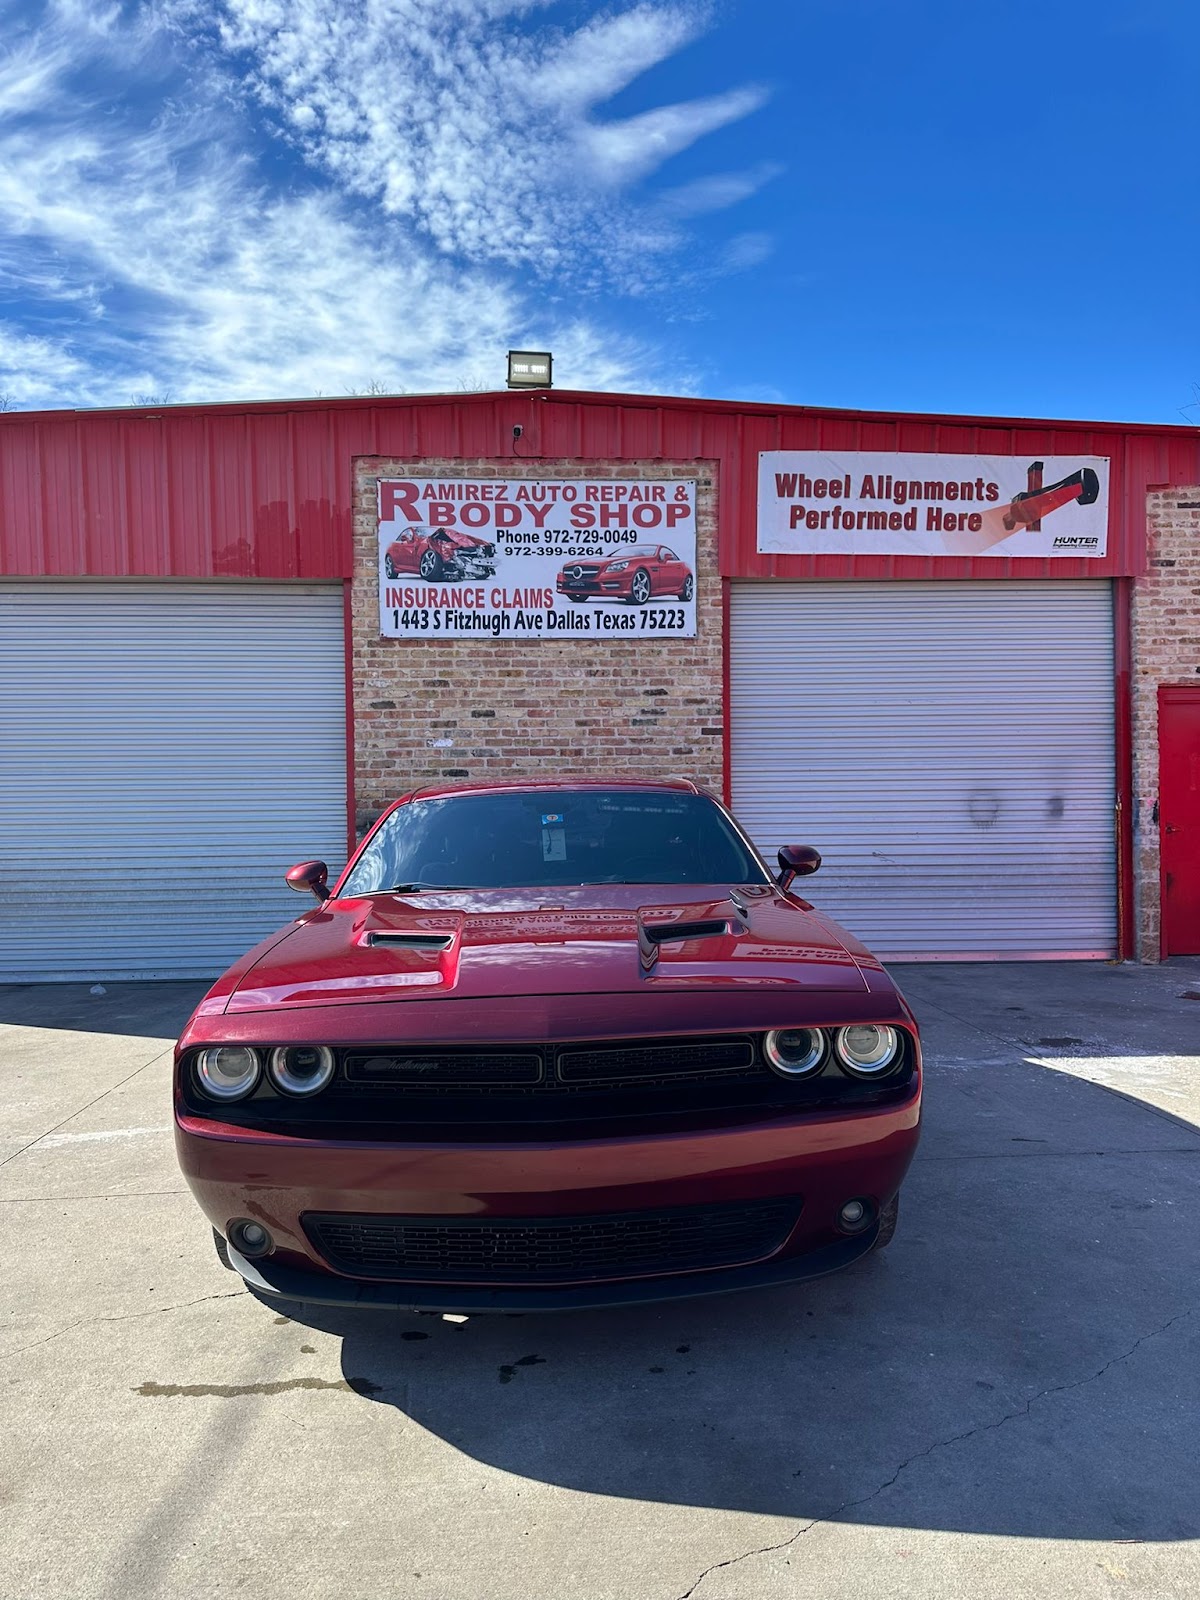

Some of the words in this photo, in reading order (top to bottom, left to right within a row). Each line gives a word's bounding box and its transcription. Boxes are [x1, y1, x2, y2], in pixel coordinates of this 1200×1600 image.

[379, 481, 508, 522] RAMIREZ
[515, 485, 578, 502] AUTO
[585, 485, 667, 502] REPAIR
[673, 485, 689, 502] &
[775, 473, 850, 498] Wheel
[859, 475, 999, 504] Alignments
[428, 503, 556, 528] BODY
[569, 503, 691, 528] SHOP
[789, 505, 917, 531] Performed
[926, 507, 982, 532] Here
[496, 529, 540, 543] Phone
[544, 530, 637, 544] 972-729-0049
[504, 546, 603, 556] 972-399-6264
[385, 587, 485, 608] INSURANCE
[491, 588, 554, 608] CLAIMS
[393, 610, 429, 629] 1443
[433, 610, 441, 629] S
[445, 610, 511, 636] Fitzhugh
[514, 611, 543, 629] Ave
[547, 610, 590, 629] Dallas
[594, 611, 636, 629] Texas
[639, 609, 685, 629] 75223
